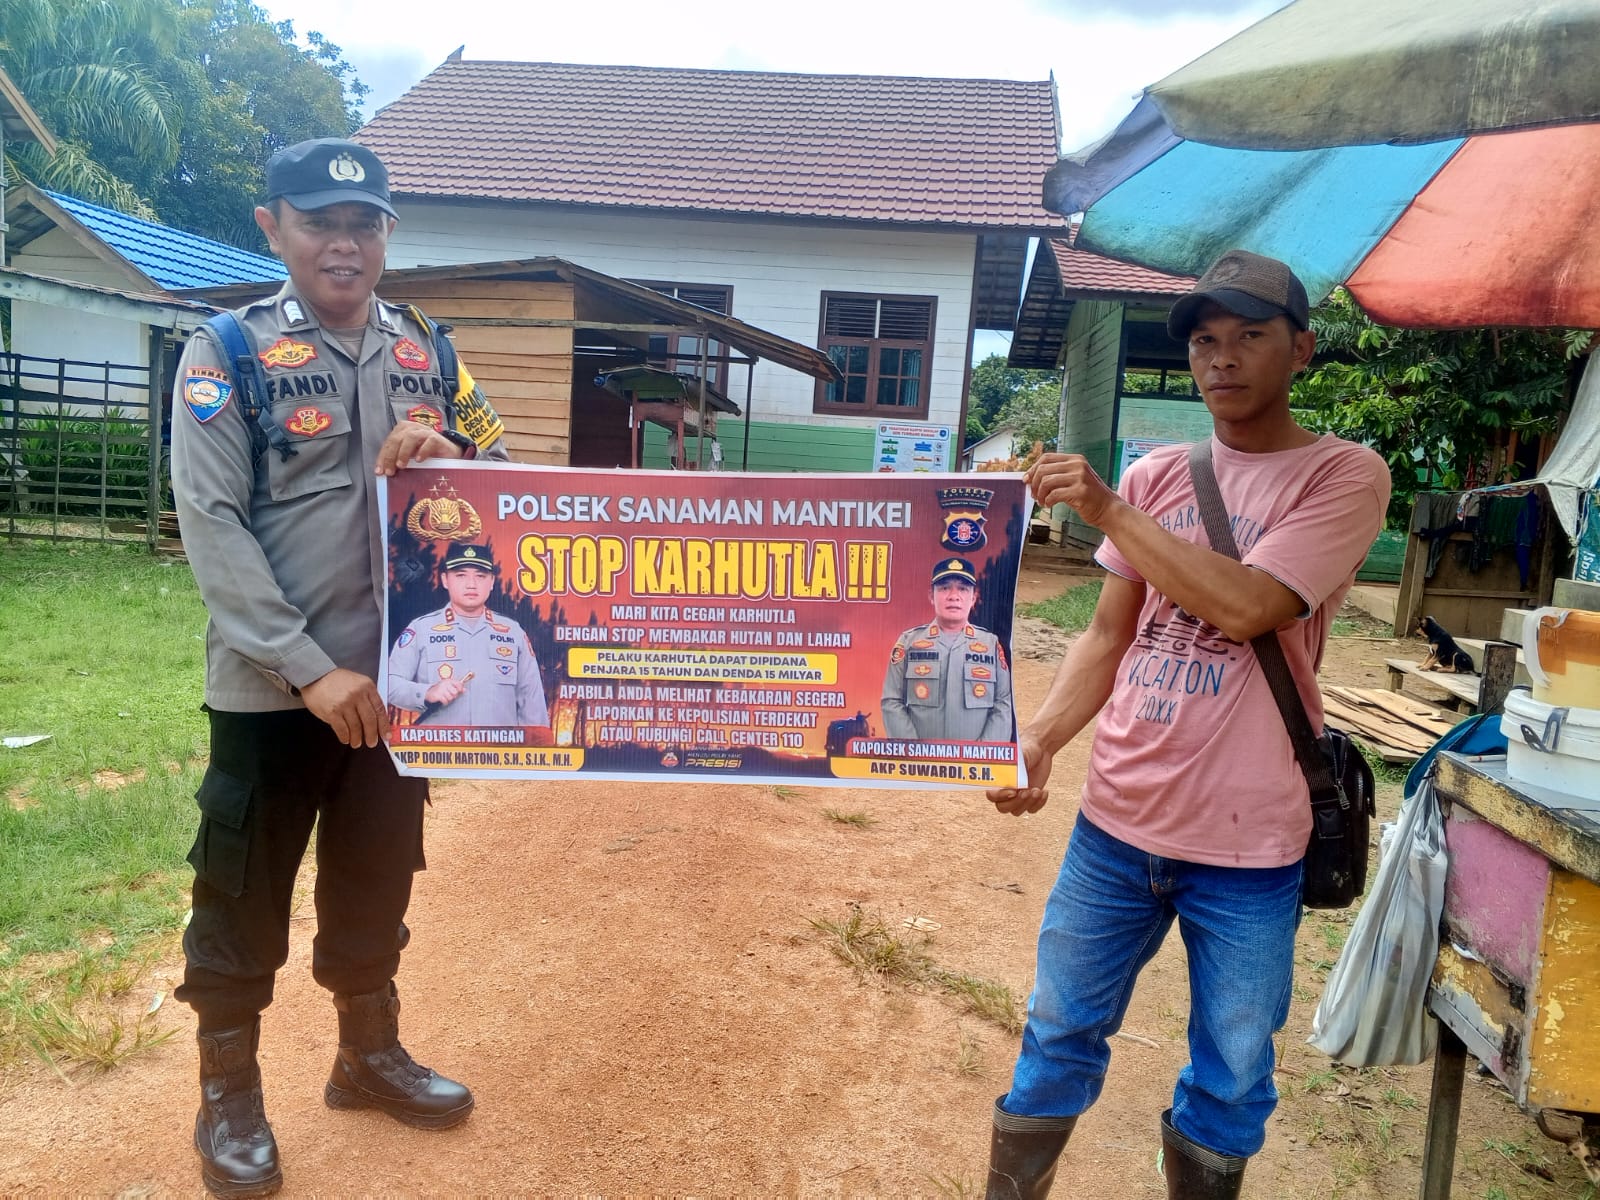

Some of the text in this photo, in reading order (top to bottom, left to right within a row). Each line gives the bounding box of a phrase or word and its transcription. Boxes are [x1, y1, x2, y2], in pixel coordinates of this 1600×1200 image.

[266, 373, 338, 402] FANDI
[389, 373, 442, 396] POLR
[498, 494, 912, 529] POLSEK SANAMAN MANTIKEI
[519, 534, 889, 600] STOP KARHUTLA !!!
[612, 605, 796, 624] MARI KITA CEGAH KARHUTLA
[429, 634, 456, 644] DODIK
[490, 634, 515, 644] POLRI
[556, 626, 851, 648] DENGAN STOP MEMBAKAR HUTAN DAN LAHAN
[597, 652, 807, 667] PELAKU KARHUTLA DAPAT DIPIDANA
[965, 653, 994, 665] POLRI
[583, 664, 822, 681] PENJARA 15 TAHUN DAN DENDA 15 MILYAR
[560, 685, 845, 708] APABILA ANDA MELIHAT KEBAKARAN SEGERA
[586, 705, 817, 727] LAPORKAN KE KEPOLISIAN TERDEKAT
[1136, 694, 1177, 725] 20XX
[400, 728, 524, 743] KAPOLRES KATINGAN
[600, 727, 804, 747] ATAU HUBUNGI CALL CENTER 110
[422, 752, 452, 765] DODIK
[455, 752, 501, 767] HARTONO,
[504, 753, 523, 767] S.H.,
[552, 754, 573, 766] M.H.
[852, 741, 1013, 760] KAPOLSEK SANAMAN MANTIKEI
[685, 759, 742, 769] PRESISI
[871, 762, 895, 774] AKP
[969, 767, 994, 781] S.H.
